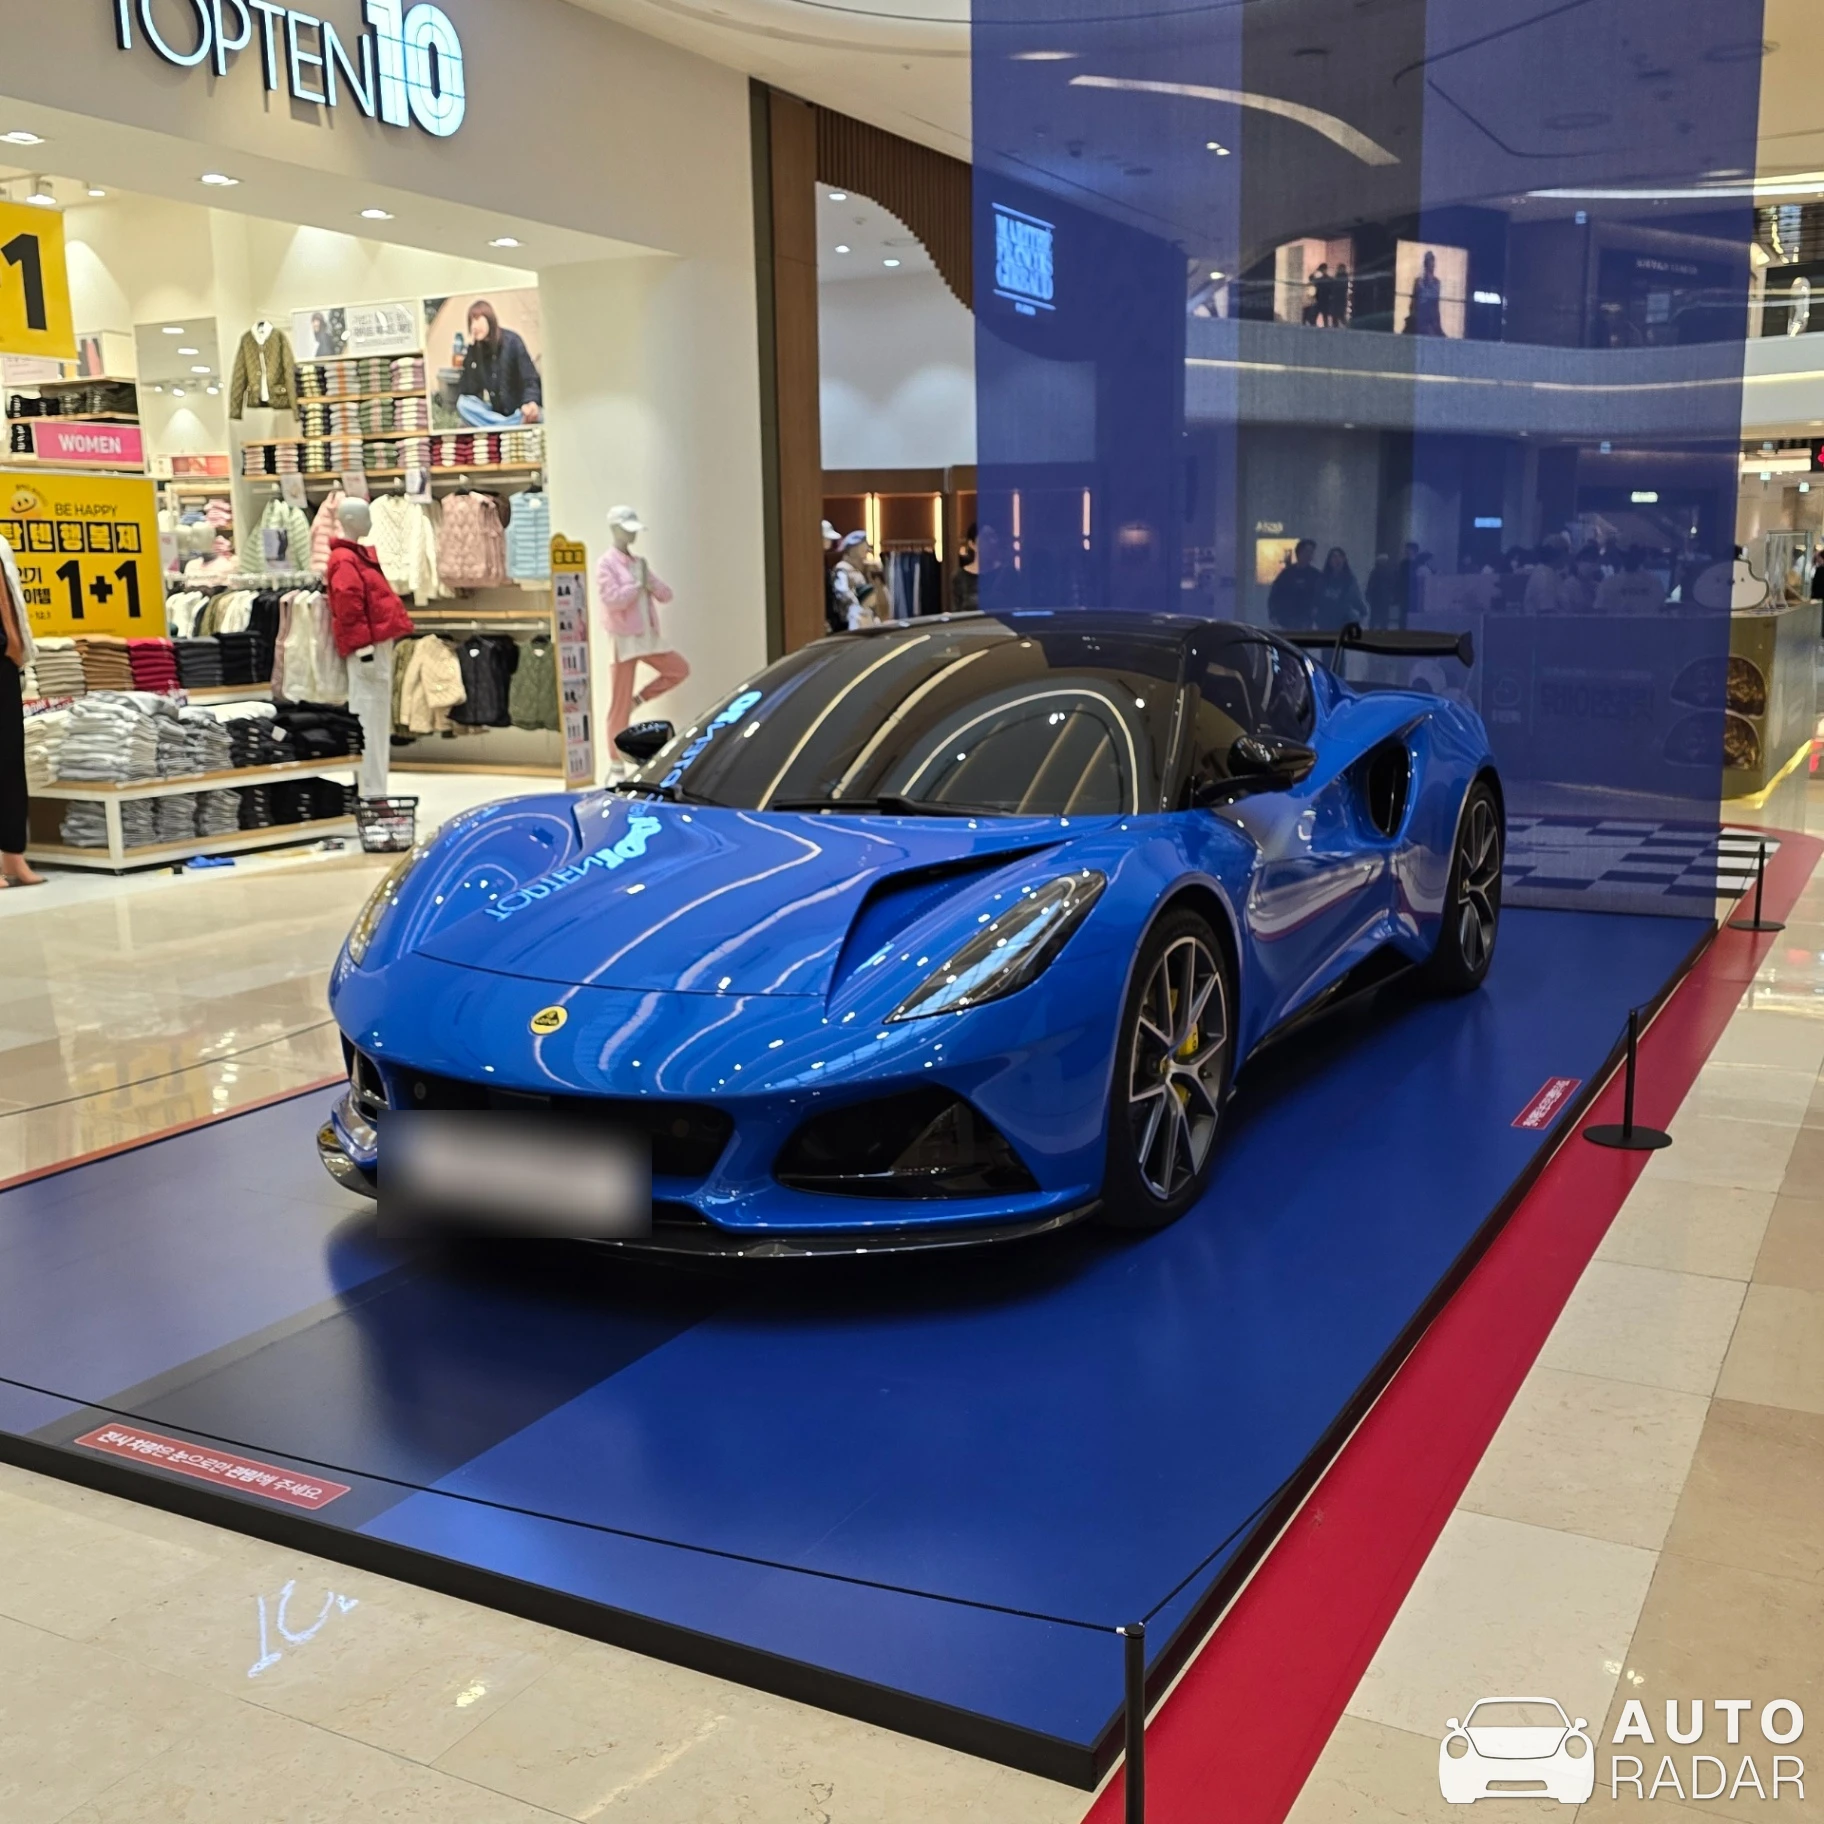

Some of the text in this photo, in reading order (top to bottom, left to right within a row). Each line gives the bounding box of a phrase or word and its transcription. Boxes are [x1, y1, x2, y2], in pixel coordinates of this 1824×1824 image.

[58, 433, 122, 455] WOMEN
[54, 503, 118, 517] BE HAPPY
[55, 560, 141, 619] 1+1
[97, 1431, 323, 1500] 전시 차량은 눈으로만 관람해 주세요
